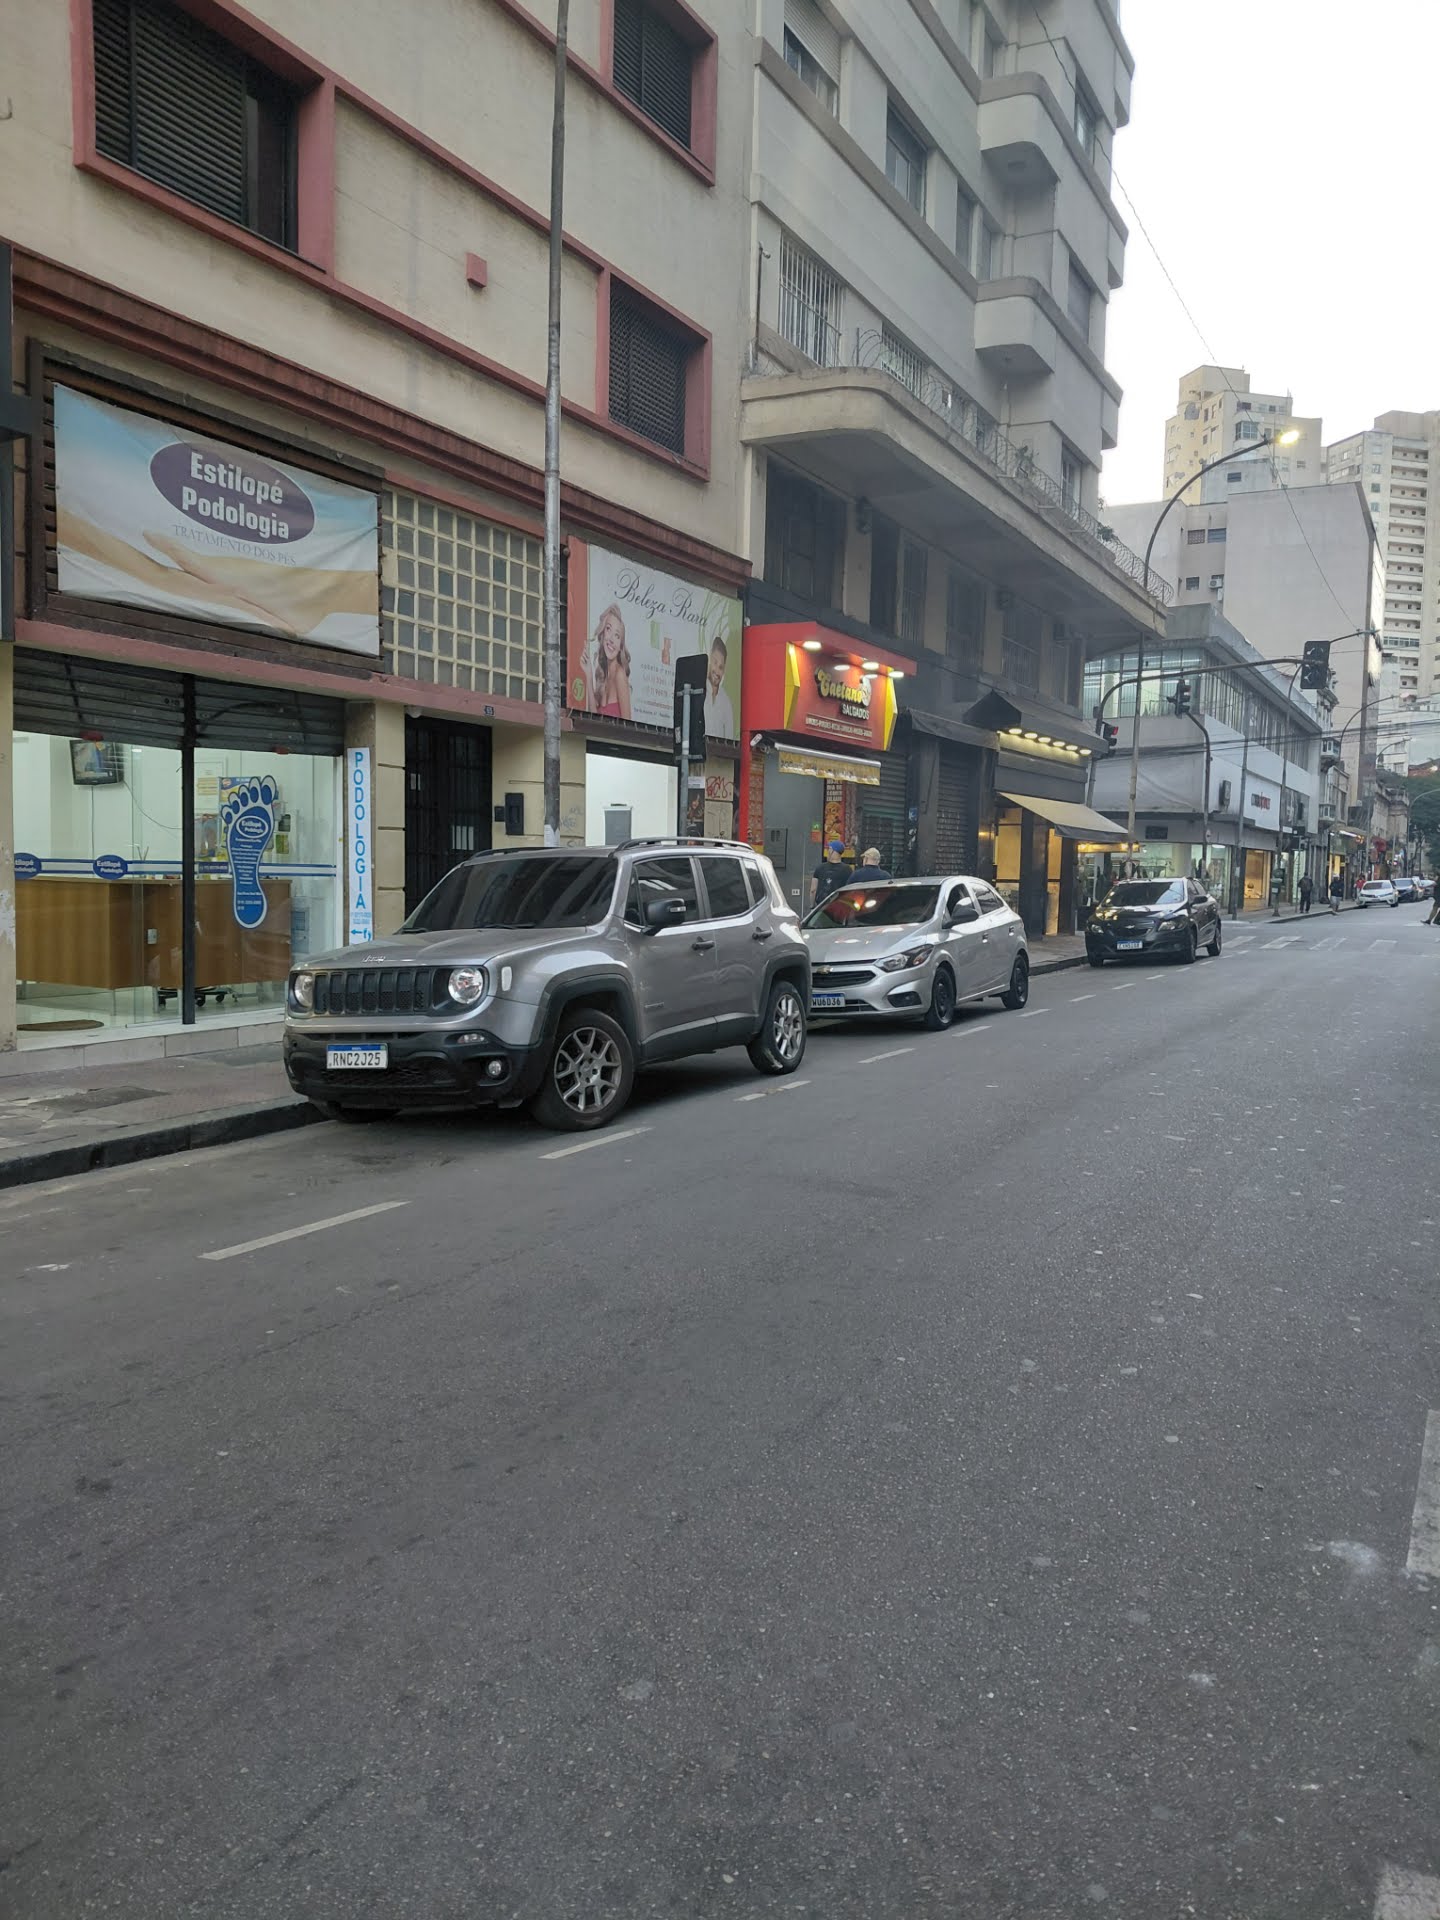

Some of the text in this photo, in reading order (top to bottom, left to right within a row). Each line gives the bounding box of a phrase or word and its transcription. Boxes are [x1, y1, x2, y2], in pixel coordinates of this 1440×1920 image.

[190, 451, 283, 504] Estilopé
[182, 486, 289, 539] Podologia
[174, 524, 250, 553] TRATAMENTO
[254, 546, 276, 561] DOS
[614, 568, 708, 626] Beleza Rara
[842, 703, 870, 720] SALGADOS
[353, 751, 366, 909] PODOLOGIA
[333, 1052, 381, 1066] RNC2J25
